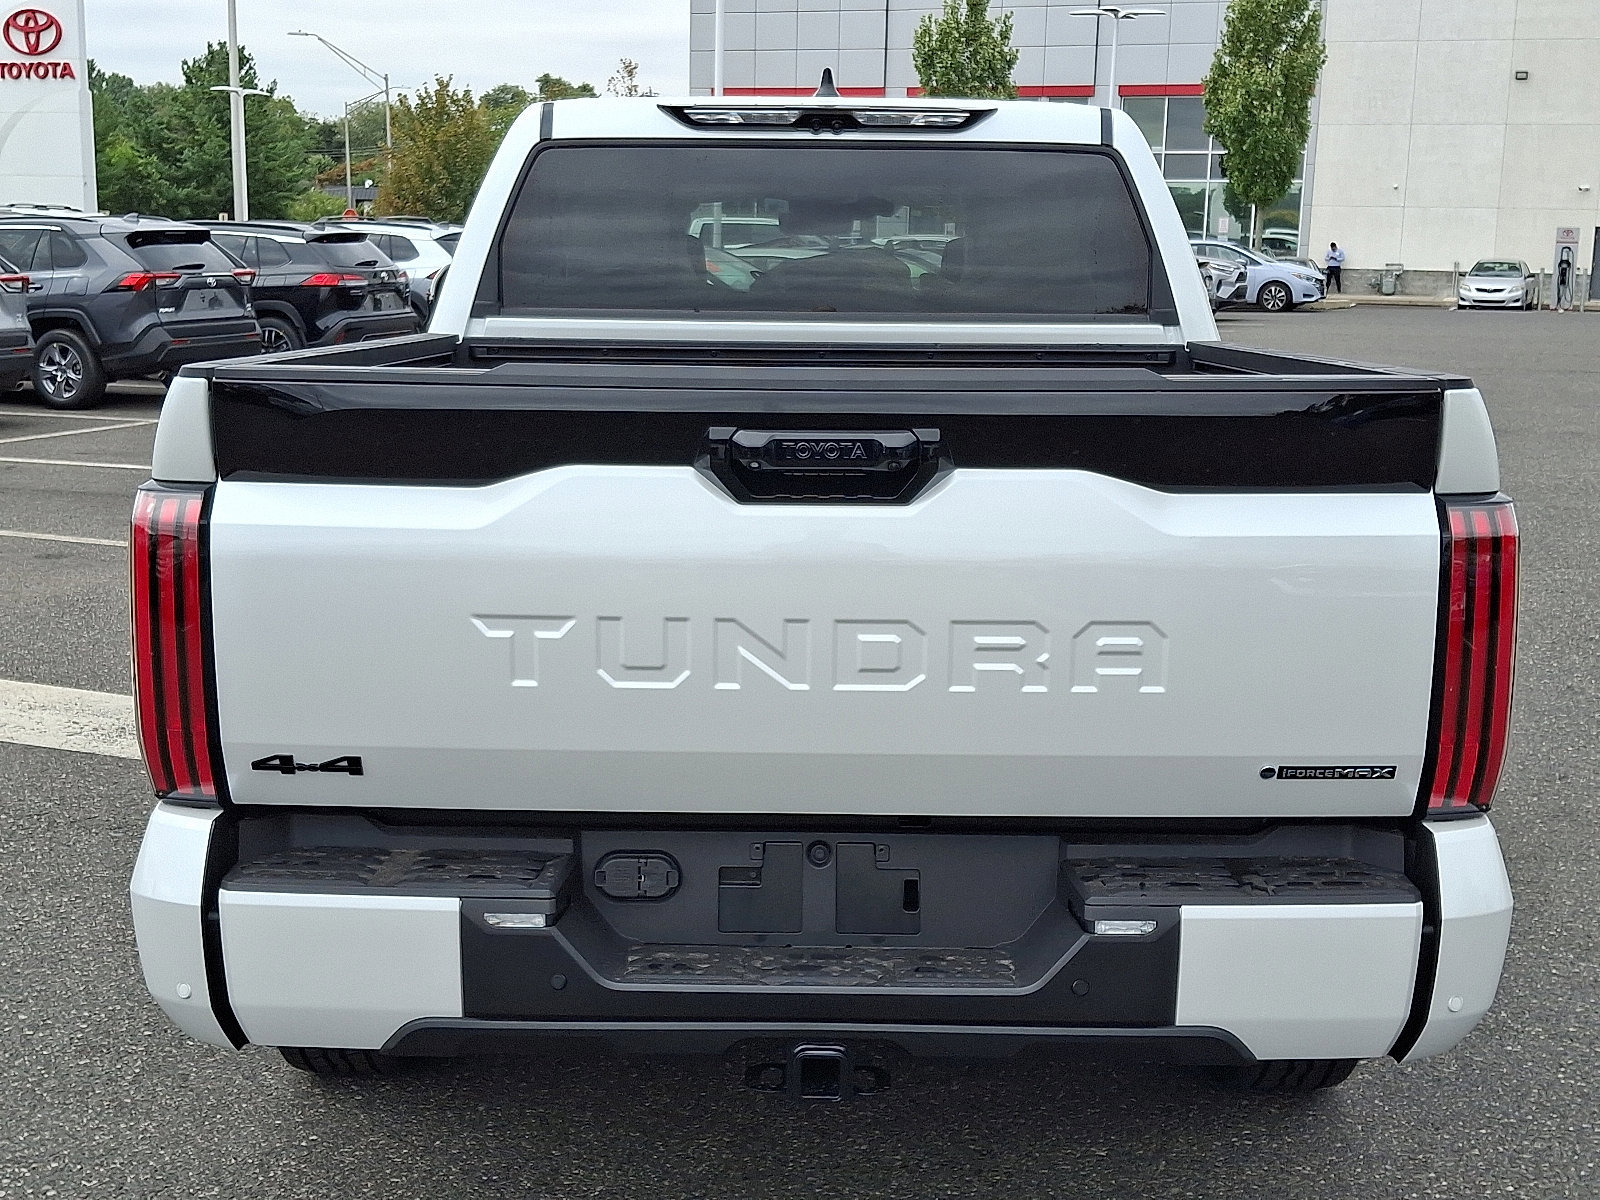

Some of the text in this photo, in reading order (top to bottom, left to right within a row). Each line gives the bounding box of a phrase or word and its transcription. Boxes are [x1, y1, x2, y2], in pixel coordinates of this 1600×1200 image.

[0, 62, 75, 79] TOYOTA
[782, 442, 867, 459] TOYOTA
[471, 614, 1168, 693] TUNDRA
[251, 754, 364, 776] 4x4
